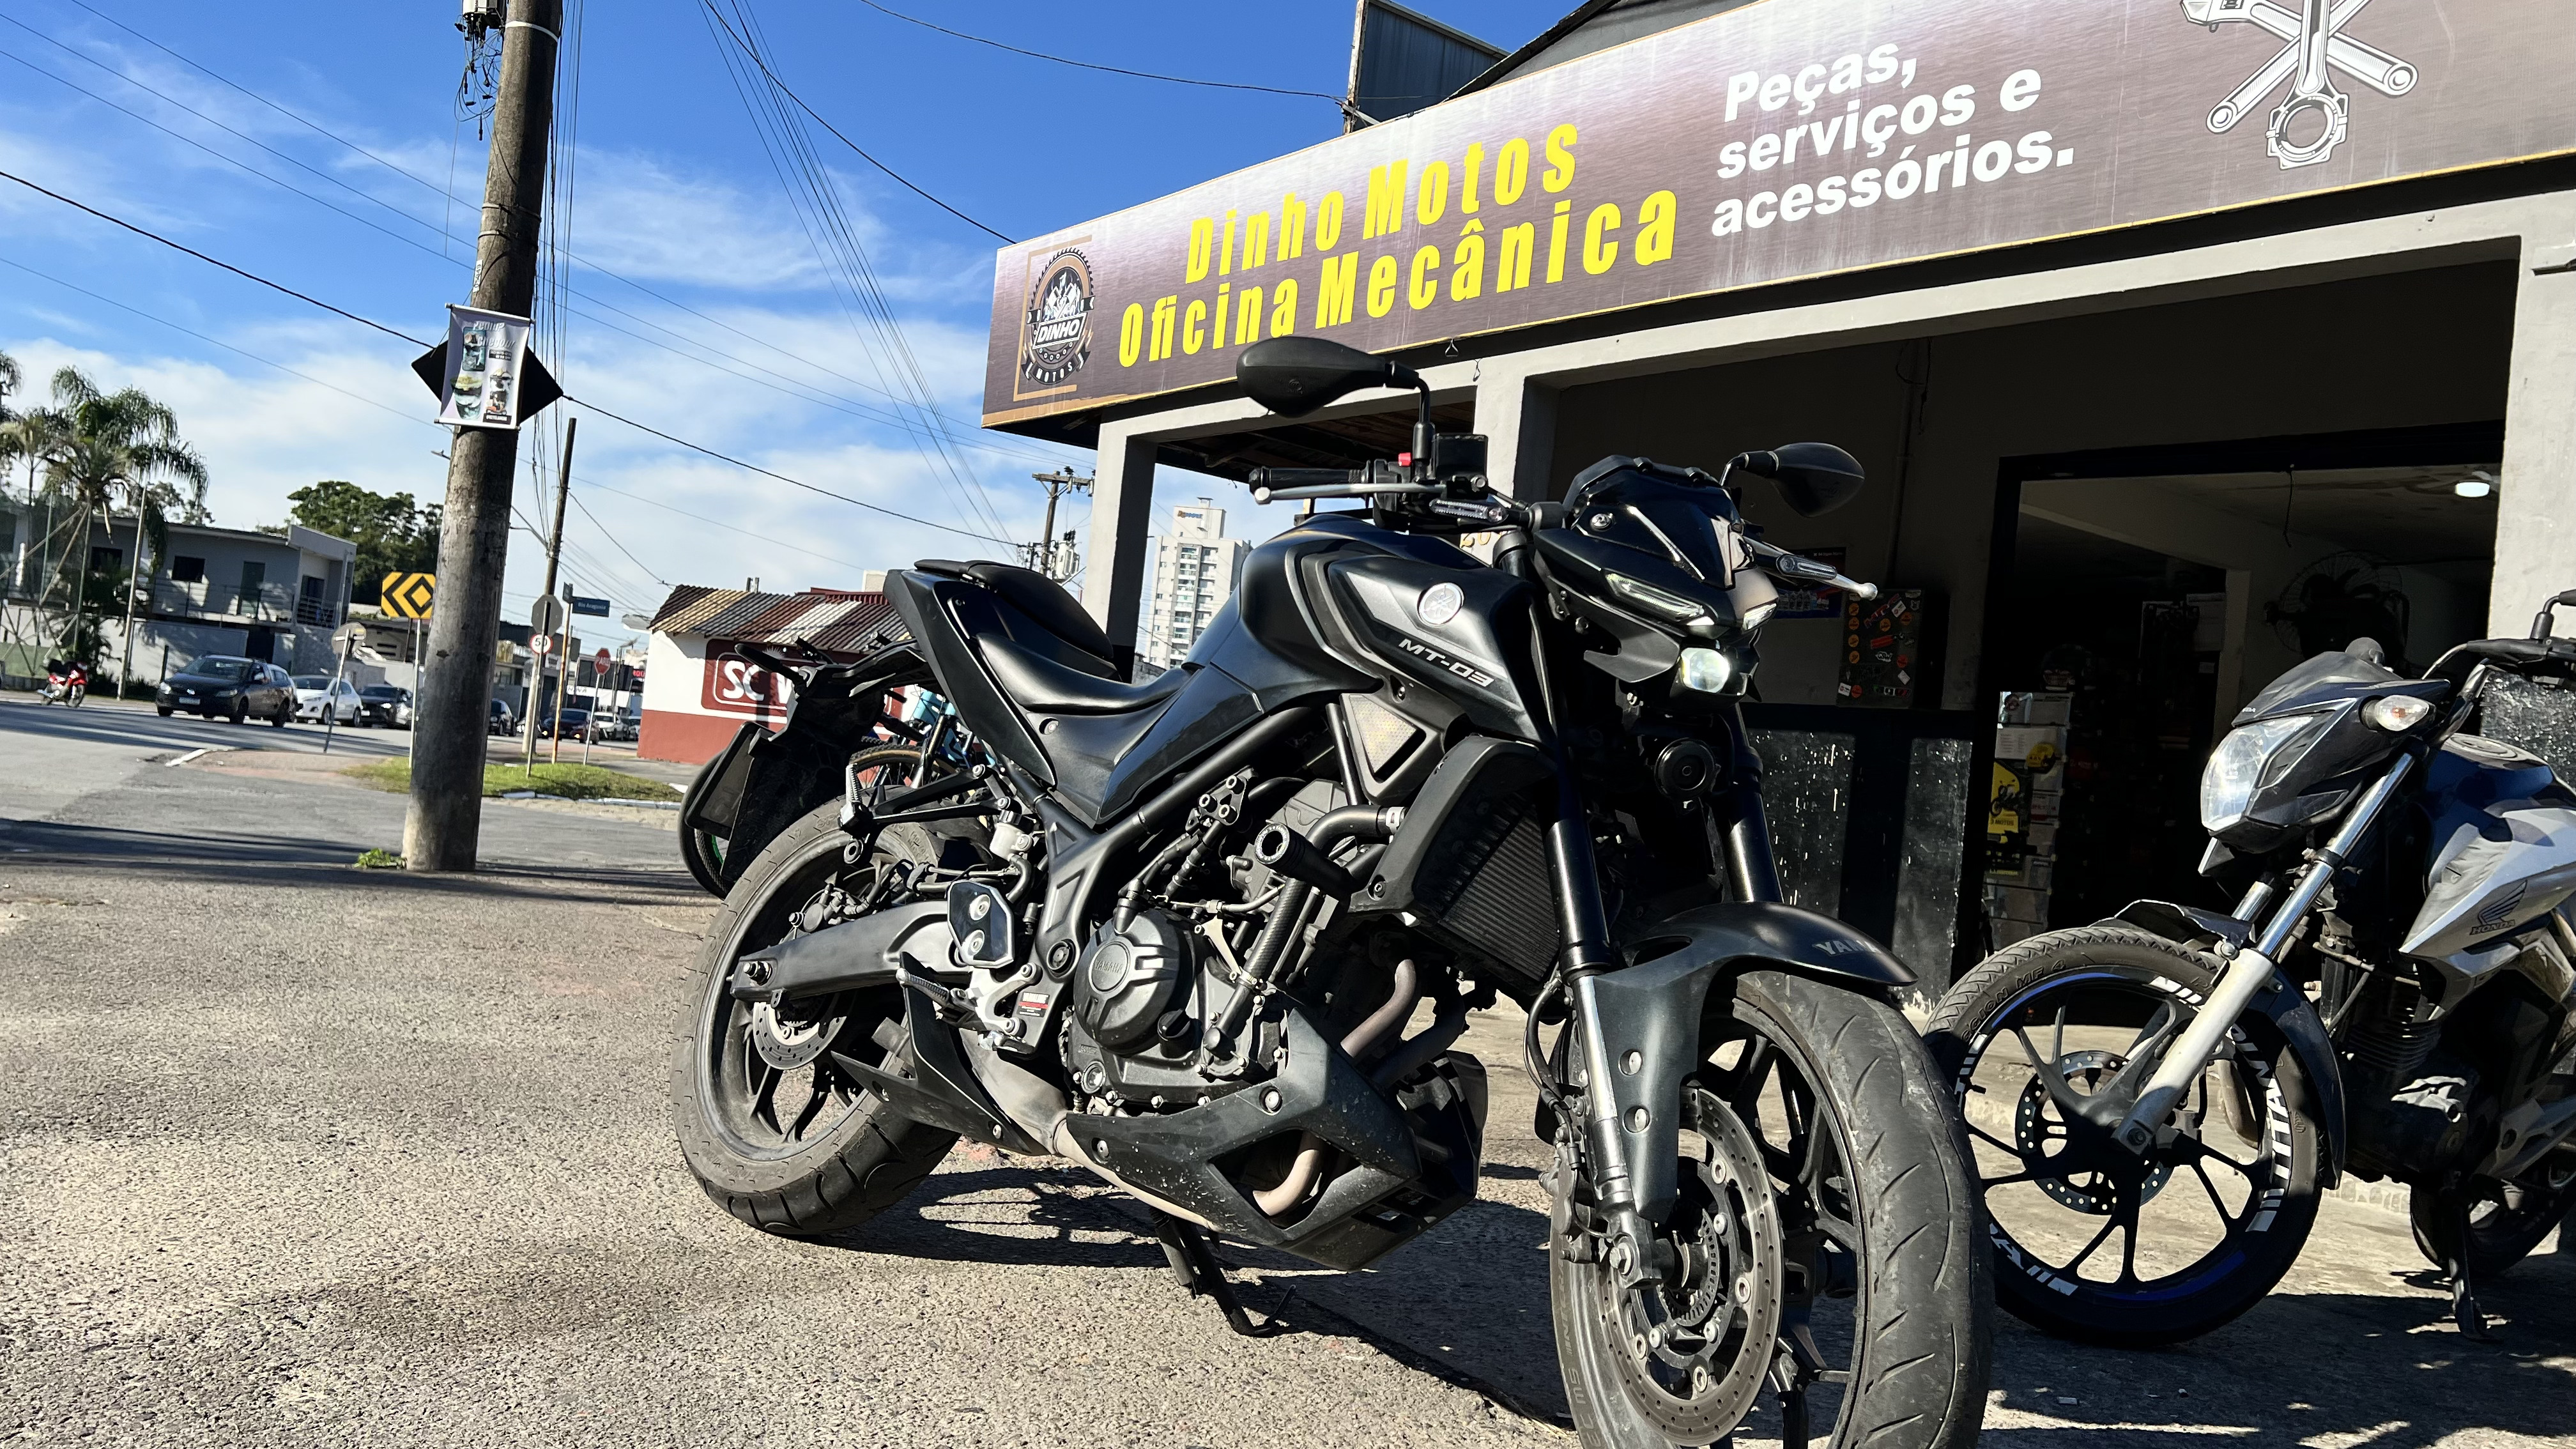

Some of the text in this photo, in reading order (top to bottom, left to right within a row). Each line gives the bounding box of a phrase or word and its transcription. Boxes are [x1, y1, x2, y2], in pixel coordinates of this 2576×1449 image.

[1724, 42, 1917, 123] Peças,
[1717, 69, 2041, 180] serviços e
[1186, 123, 1578, 284] Dinho Motos
[1711, 130, 2074, 237] acessórios.
[1119, 191, 1678, 368] Oficina Mecânica
[1036, 319, 1081, 344] DINHO
[1036, 361, 1073, 383] MOTOS
[723, 659, 765, 702] SC
[1398, 638, 1495, 688] MT-03
[2470, 920, 2515, 935] HONDA
[1094, 959, 1124, 974] YAMAHA
[2016, 965, 2045, 990] MF
[2051, 958, 2067, 972] 4
